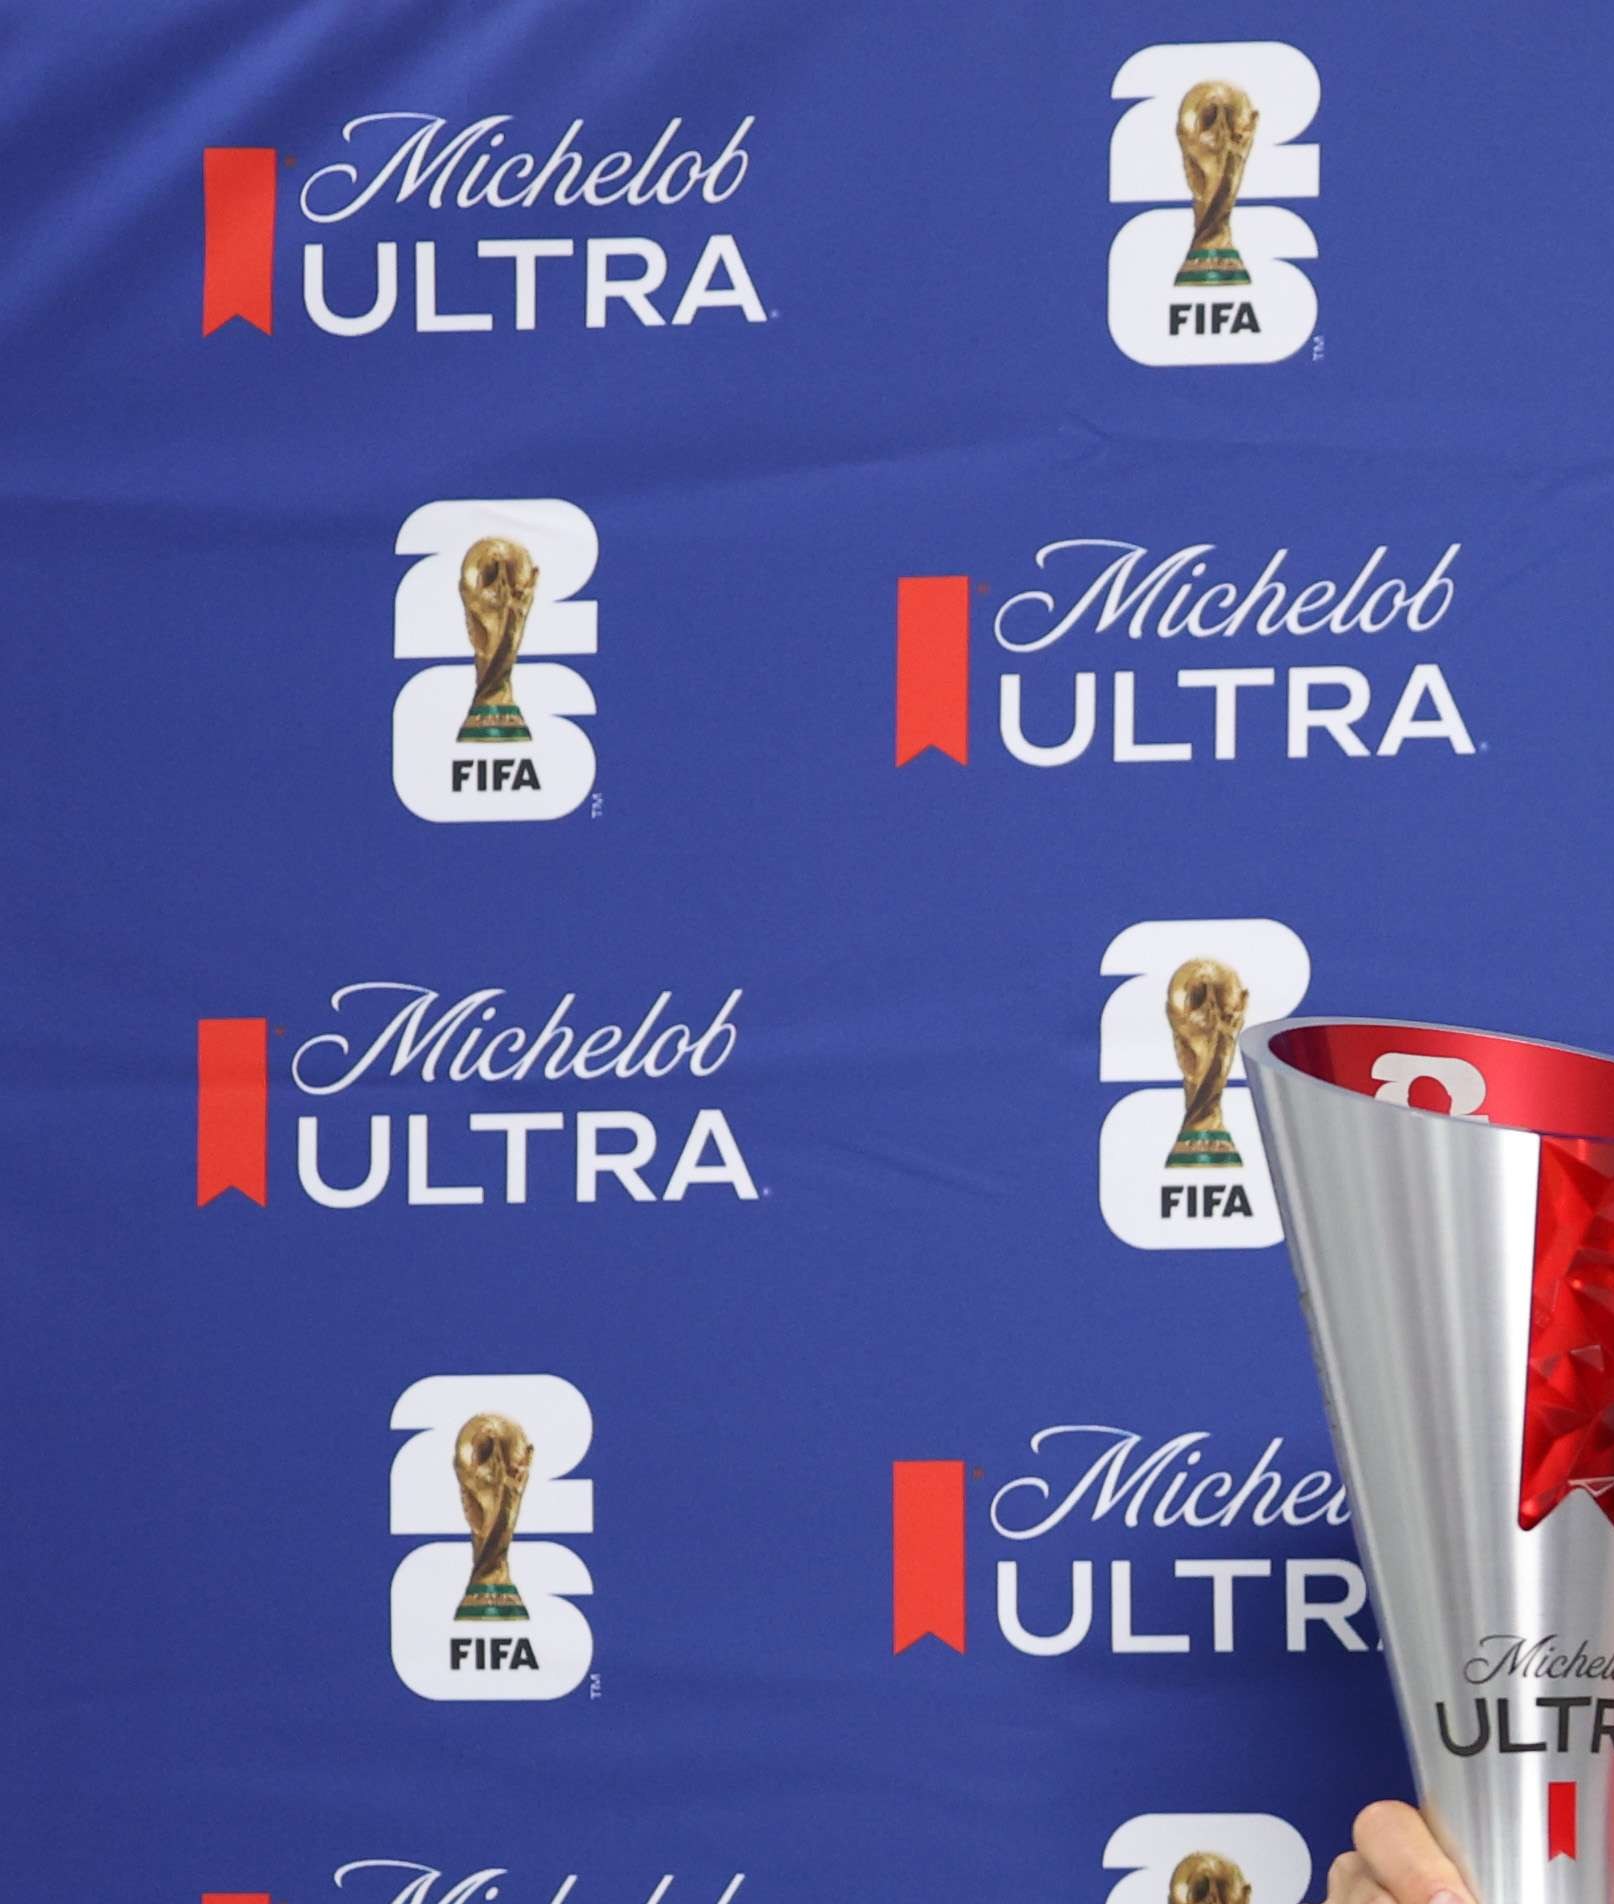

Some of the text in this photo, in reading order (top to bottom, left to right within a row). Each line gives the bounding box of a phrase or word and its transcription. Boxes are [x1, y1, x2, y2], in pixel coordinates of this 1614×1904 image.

[300, 112, 755, 223] Michelob
[303, 234, 768, 337] ULTRA
[1169, 302, 1261, 336] FIFA
[994, 538, 1462, 653] Michelob
[999, 663, 1476, 768] ULTRA
[452, 758, 541, 792] FIFA
[291, 981, 743, 1096] Michelob
[297, 1109, 759, 1209] ULTRA
[1161, 1185, 1253, 1219] FIFA
[450, 1637, 540, 1670] FIFA
[997, 1559, 1383, 1657] ULTR
